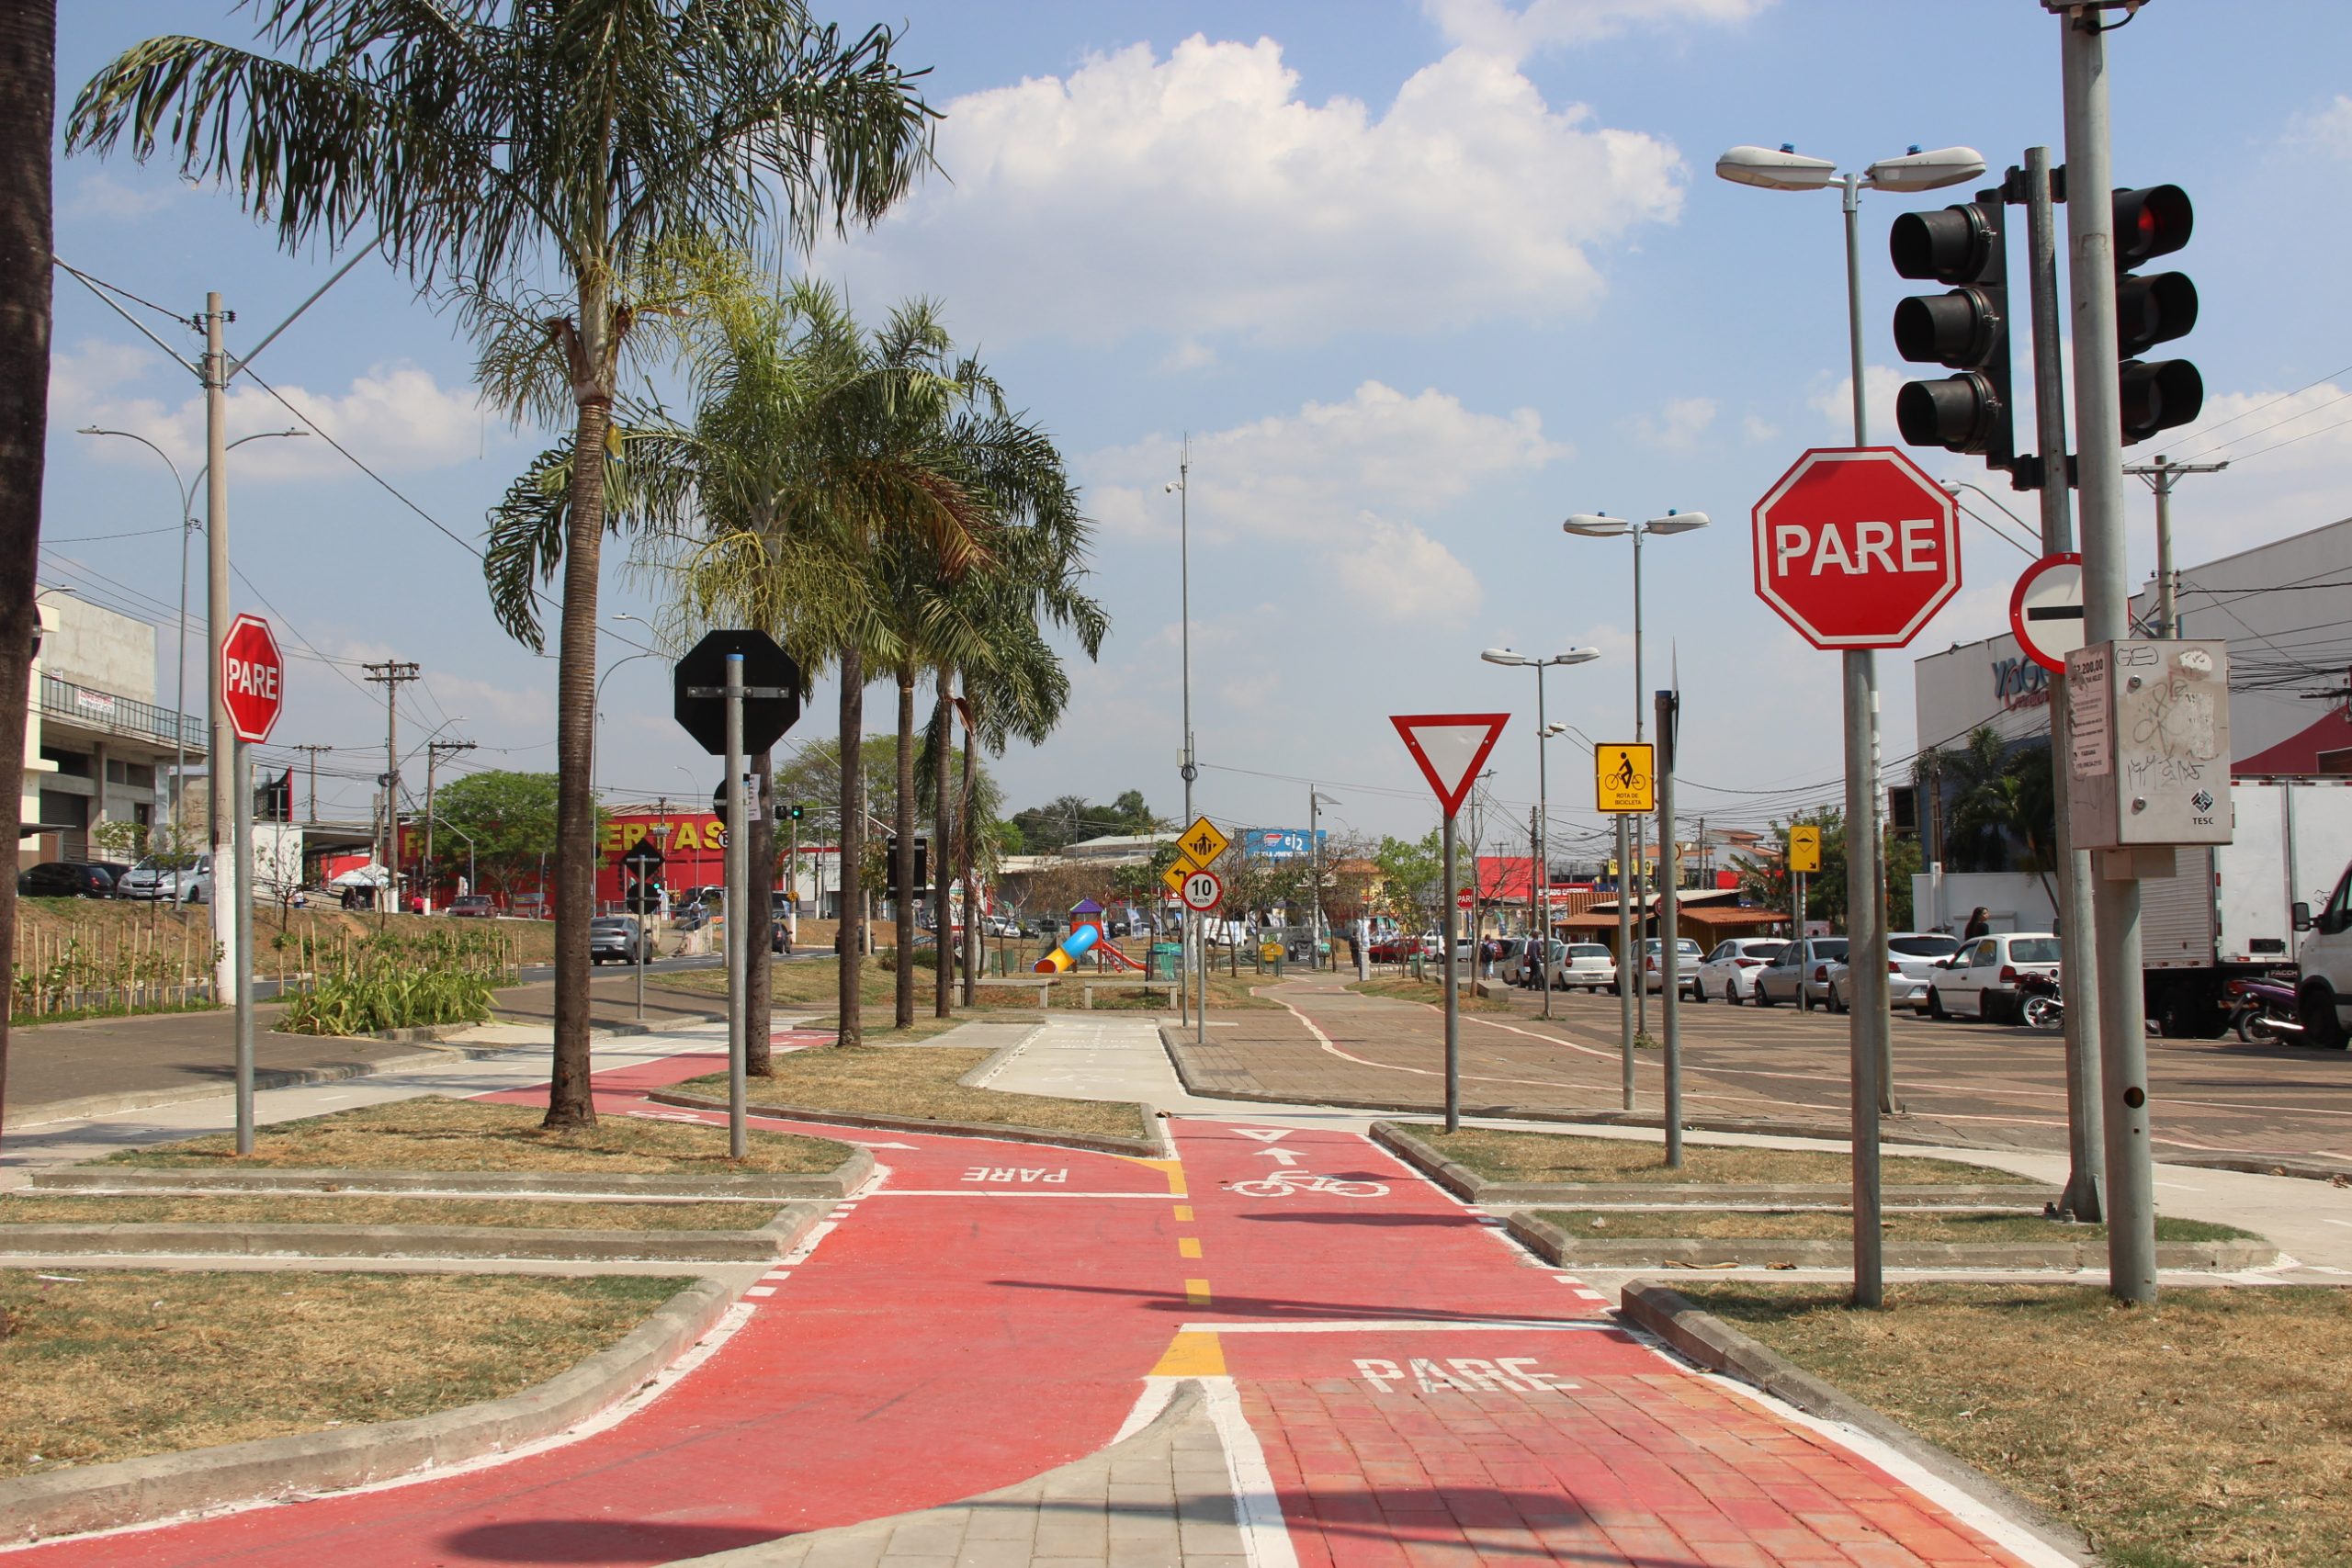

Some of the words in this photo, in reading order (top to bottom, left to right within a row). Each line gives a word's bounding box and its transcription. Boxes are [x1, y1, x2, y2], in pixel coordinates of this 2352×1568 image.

[1775, 519, 1938, 577] PARE
[228, 658, 278, 700] PARE
[2192, 817, 2213, 825] TESC
[602, 822, 724, 851] ERTAS
[1192, 879, 1212, 897] 10
[960, 1167, 1068, 1183] PARE
[1352, 1358, 1582, 1393] PARE
